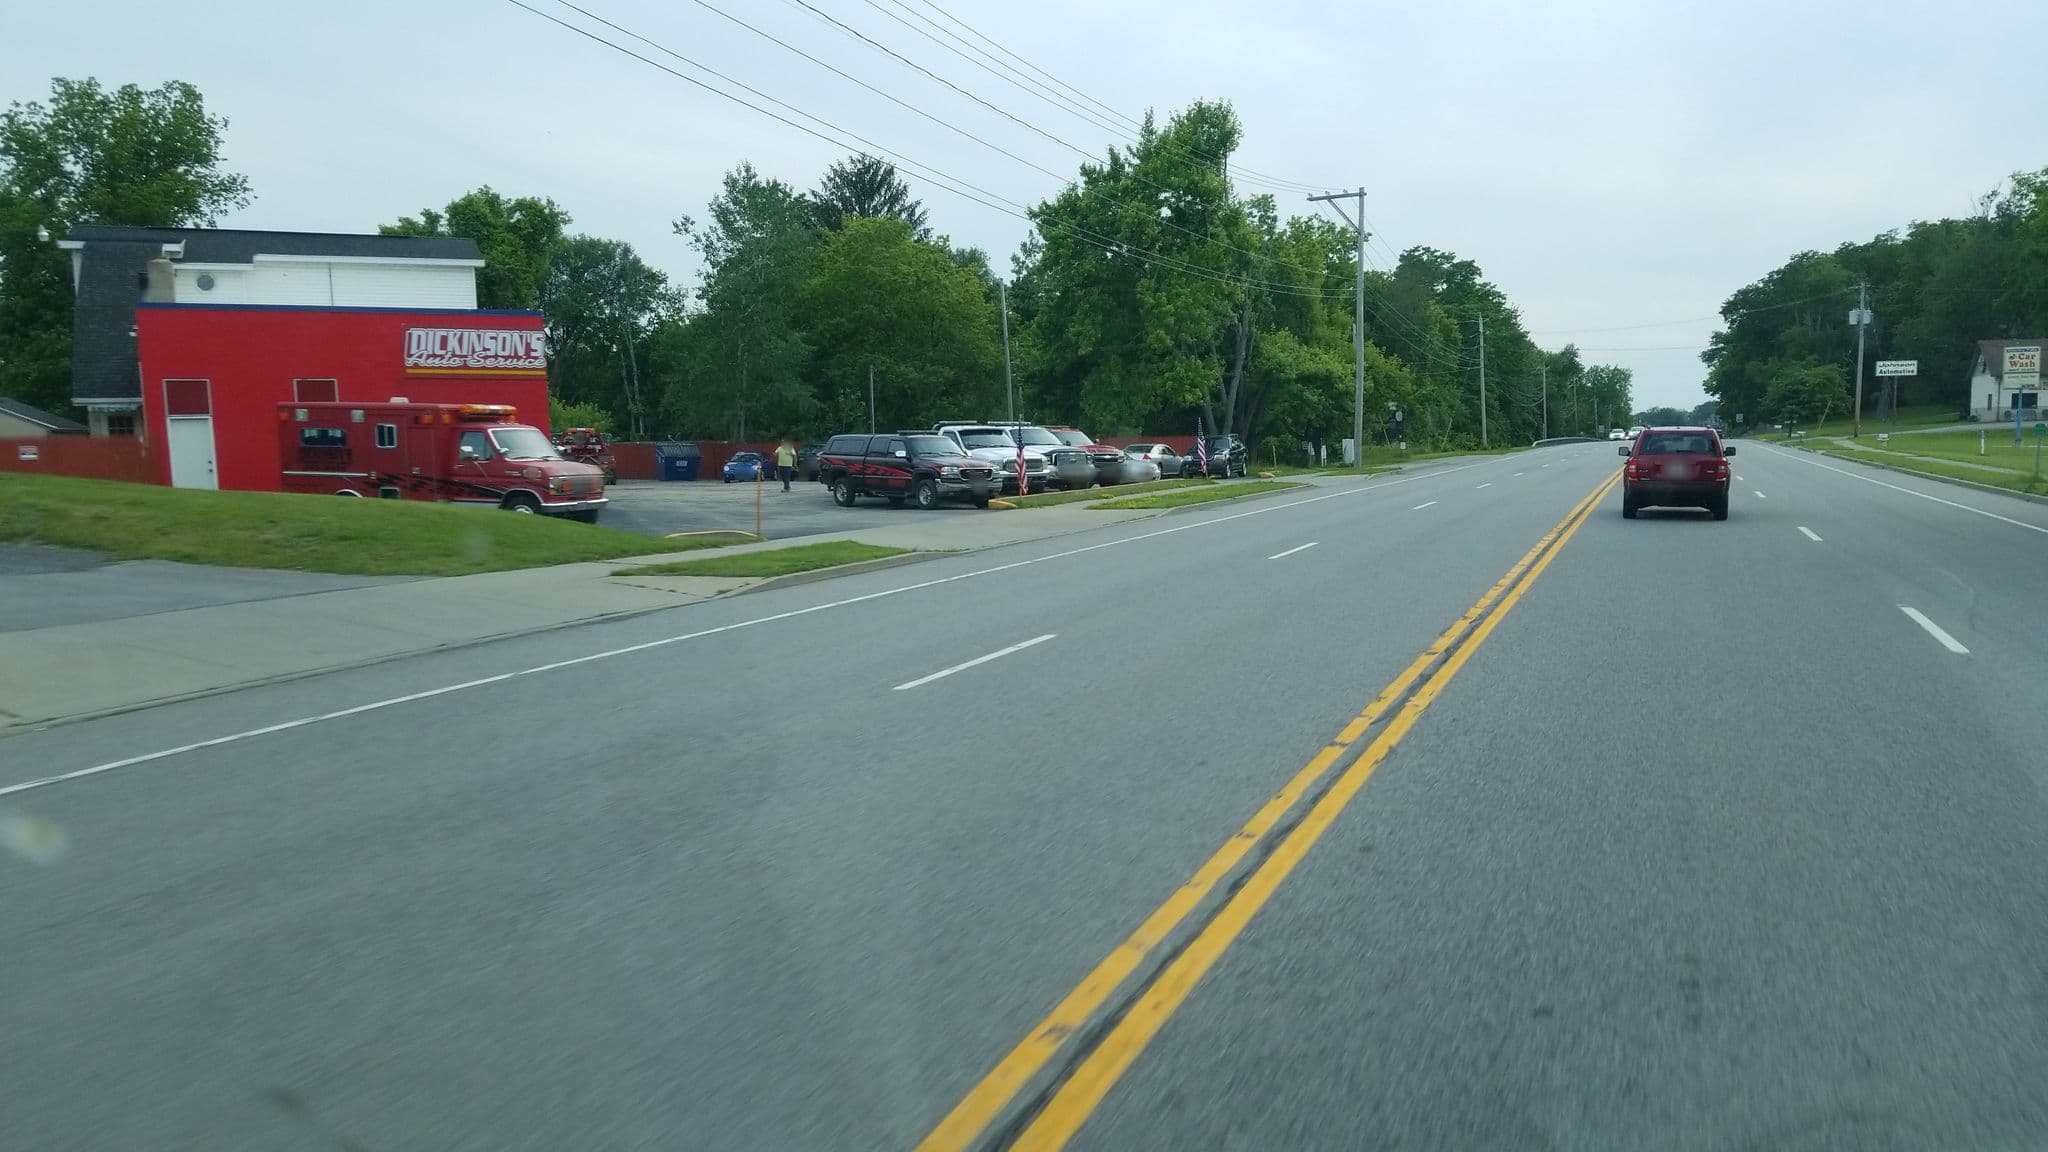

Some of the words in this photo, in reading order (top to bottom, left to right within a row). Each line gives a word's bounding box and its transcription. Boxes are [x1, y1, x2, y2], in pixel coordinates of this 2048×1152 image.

[409, 329, 546, 357] DICKINSON'S
[406, 349, 464, 367] Auto
[467, 350, 548, 368] Service
[2009, 360, 2036, 368] Wash
